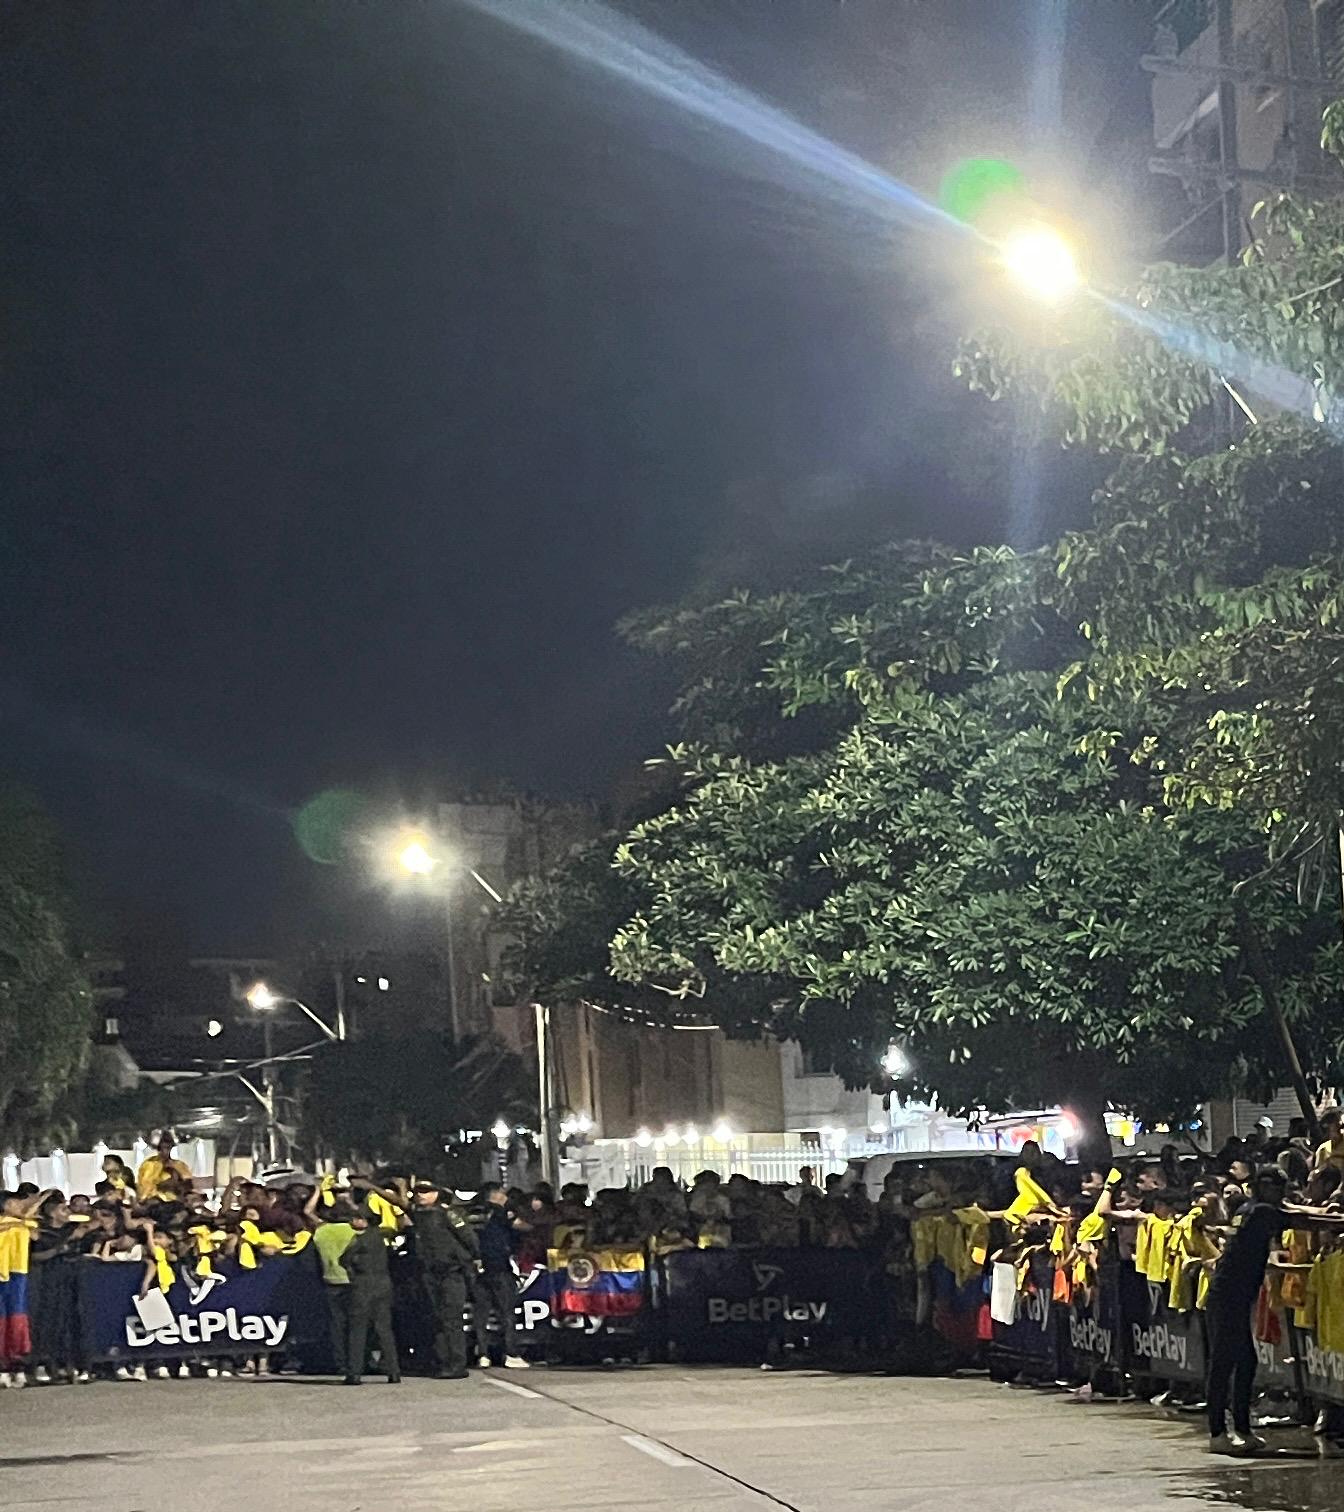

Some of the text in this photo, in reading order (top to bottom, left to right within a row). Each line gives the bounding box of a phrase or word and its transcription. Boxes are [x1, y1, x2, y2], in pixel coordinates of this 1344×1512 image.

[709, 1297, 827, 1324] BetPlay
[1069, 1314, 1112, 1363] BetPlay
[1132, 1322, 1187, 1370] BetPlay
